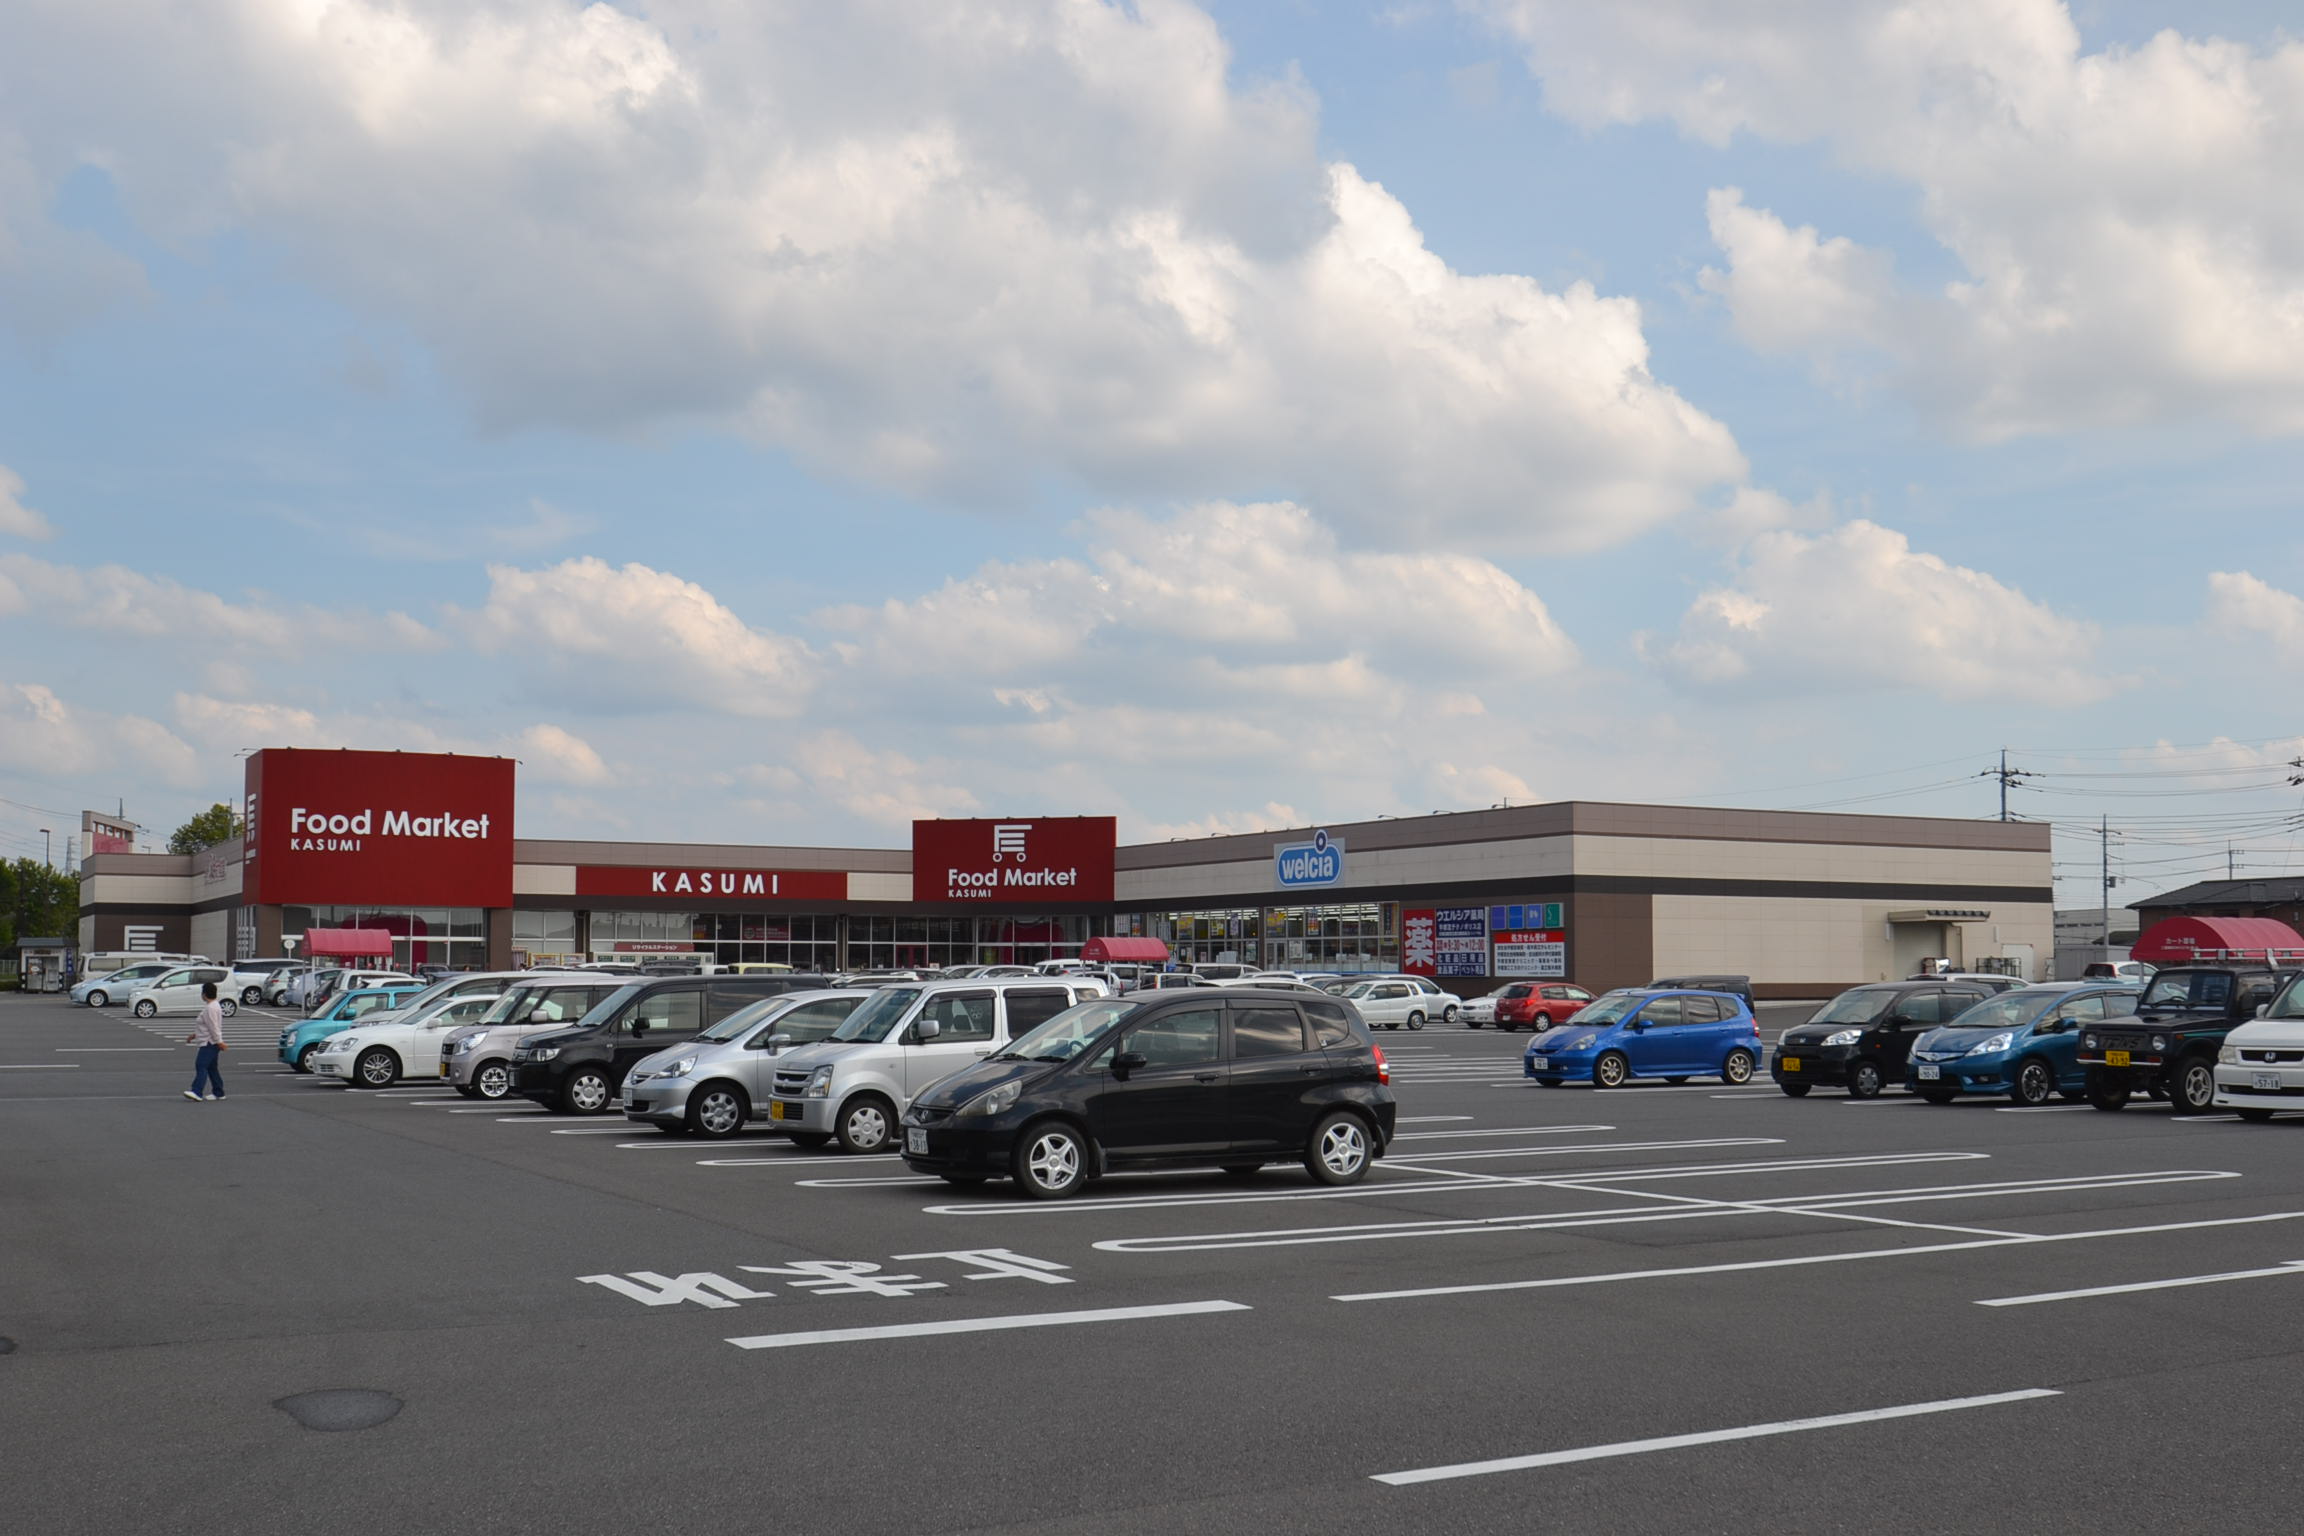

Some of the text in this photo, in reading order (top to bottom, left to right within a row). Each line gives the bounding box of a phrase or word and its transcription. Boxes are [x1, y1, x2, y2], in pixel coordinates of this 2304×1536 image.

[291, 807, 490, 839] Food Market
[290, 838, 361, 852] KASUMI
[948, 867, 1077, 887] Food Market
[1281, 851, 1334, 880] welcia
[652, 871, 778, 895] KASUMI
[948, 889, 992, 898] KASUMI
[1404, 917, 1434, 968] 薬
[575, 1247, 1076, 1309] 止まれ
